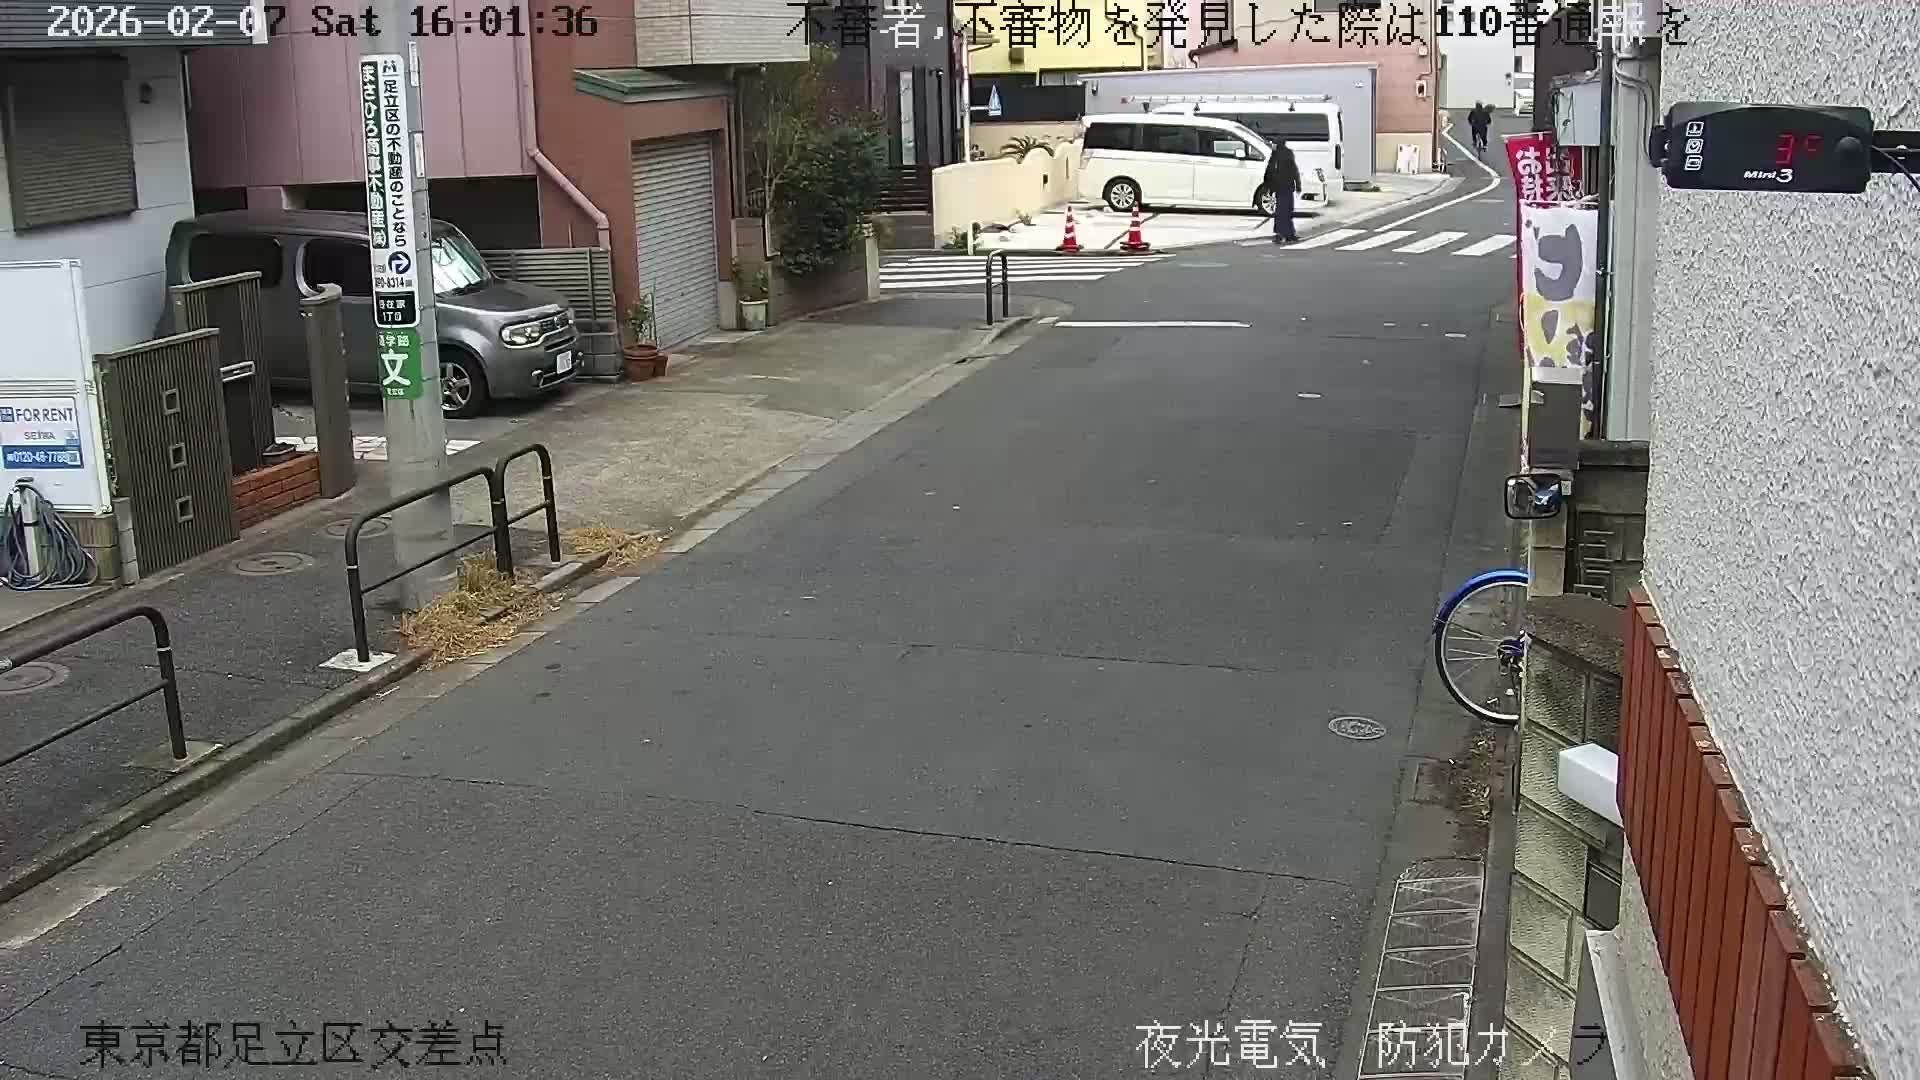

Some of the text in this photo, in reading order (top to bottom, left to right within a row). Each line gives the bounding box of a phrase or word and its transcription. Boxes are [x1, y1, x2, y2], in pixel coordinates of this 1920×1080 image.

[383, 79, 407, 247] 足立区の不動産のことなら
[380, 348, 411, 386] 文
[15, 408, 41, 422] FOR
[42, 408, 73, 422] RENT
